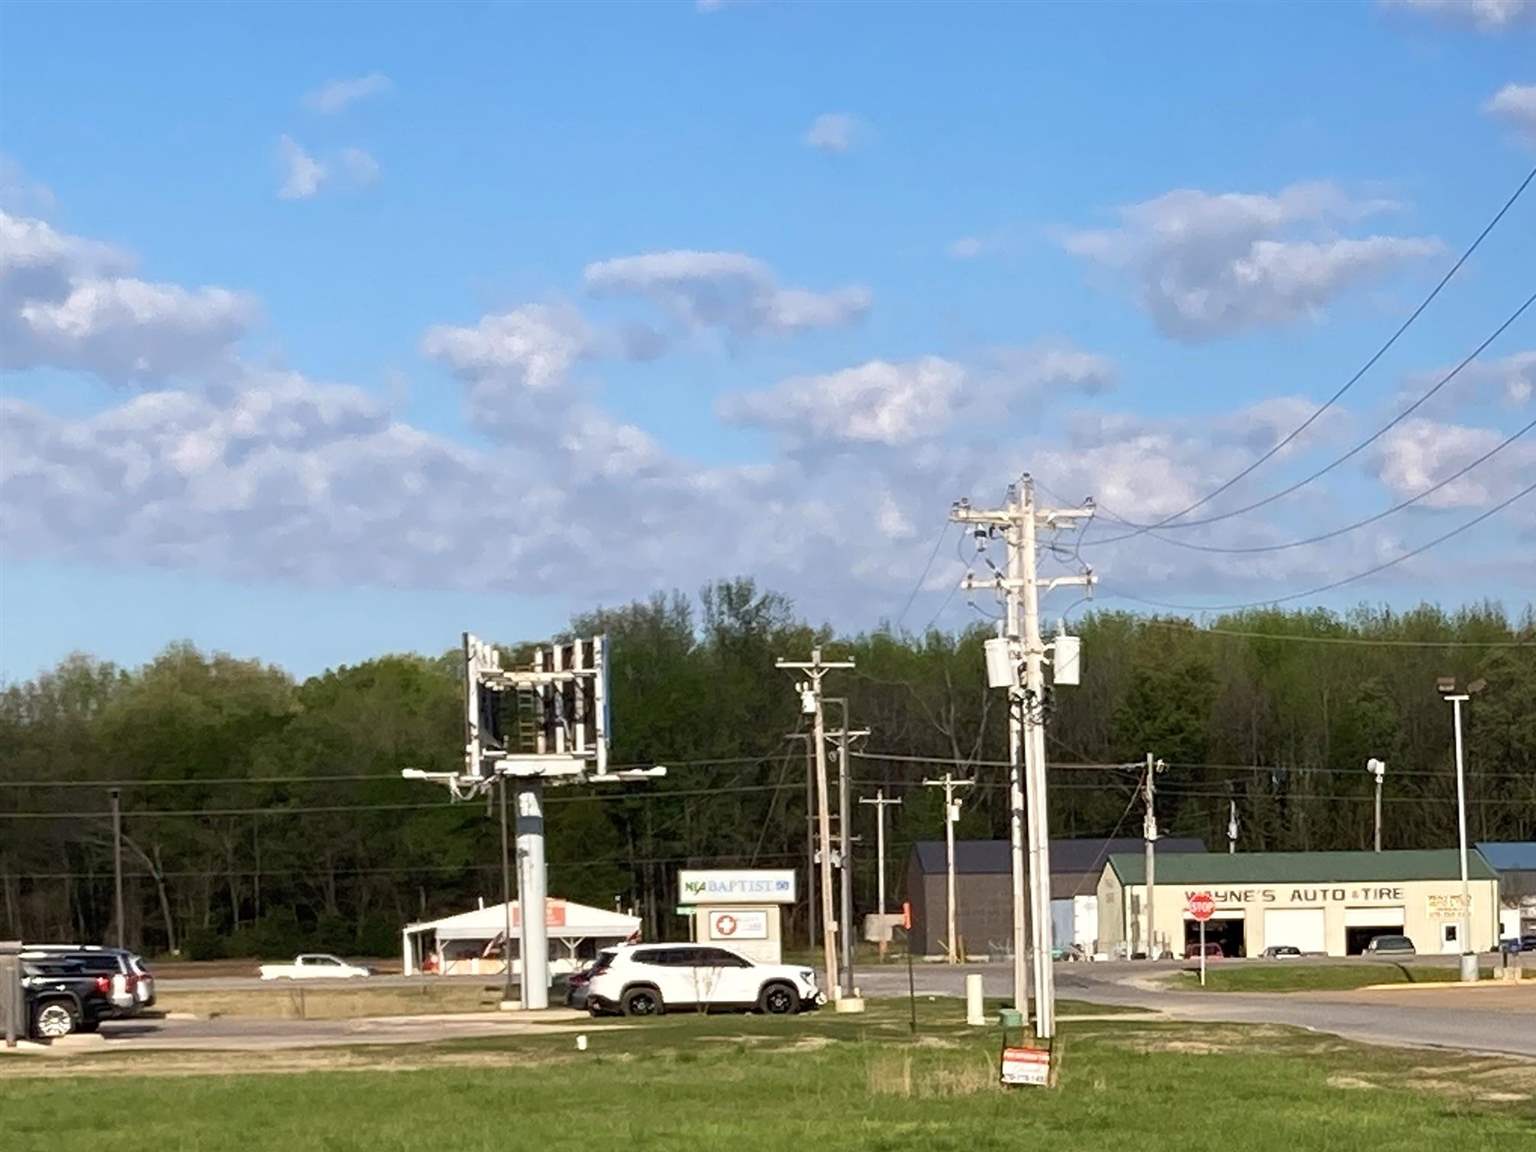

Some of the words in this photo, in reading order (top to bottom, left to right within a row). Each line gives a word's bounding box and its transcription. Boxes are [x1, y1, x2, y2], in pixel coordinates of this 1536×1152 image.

[708, 881, 773, 892] BAPTIST
[1185, 889, 1276, 902] WYNE'S
[1290, 889, 1345, 901] AUTO
[1362, 888, 1404, 900] TIRE
[1191, 901, 1214, 911] STOP
